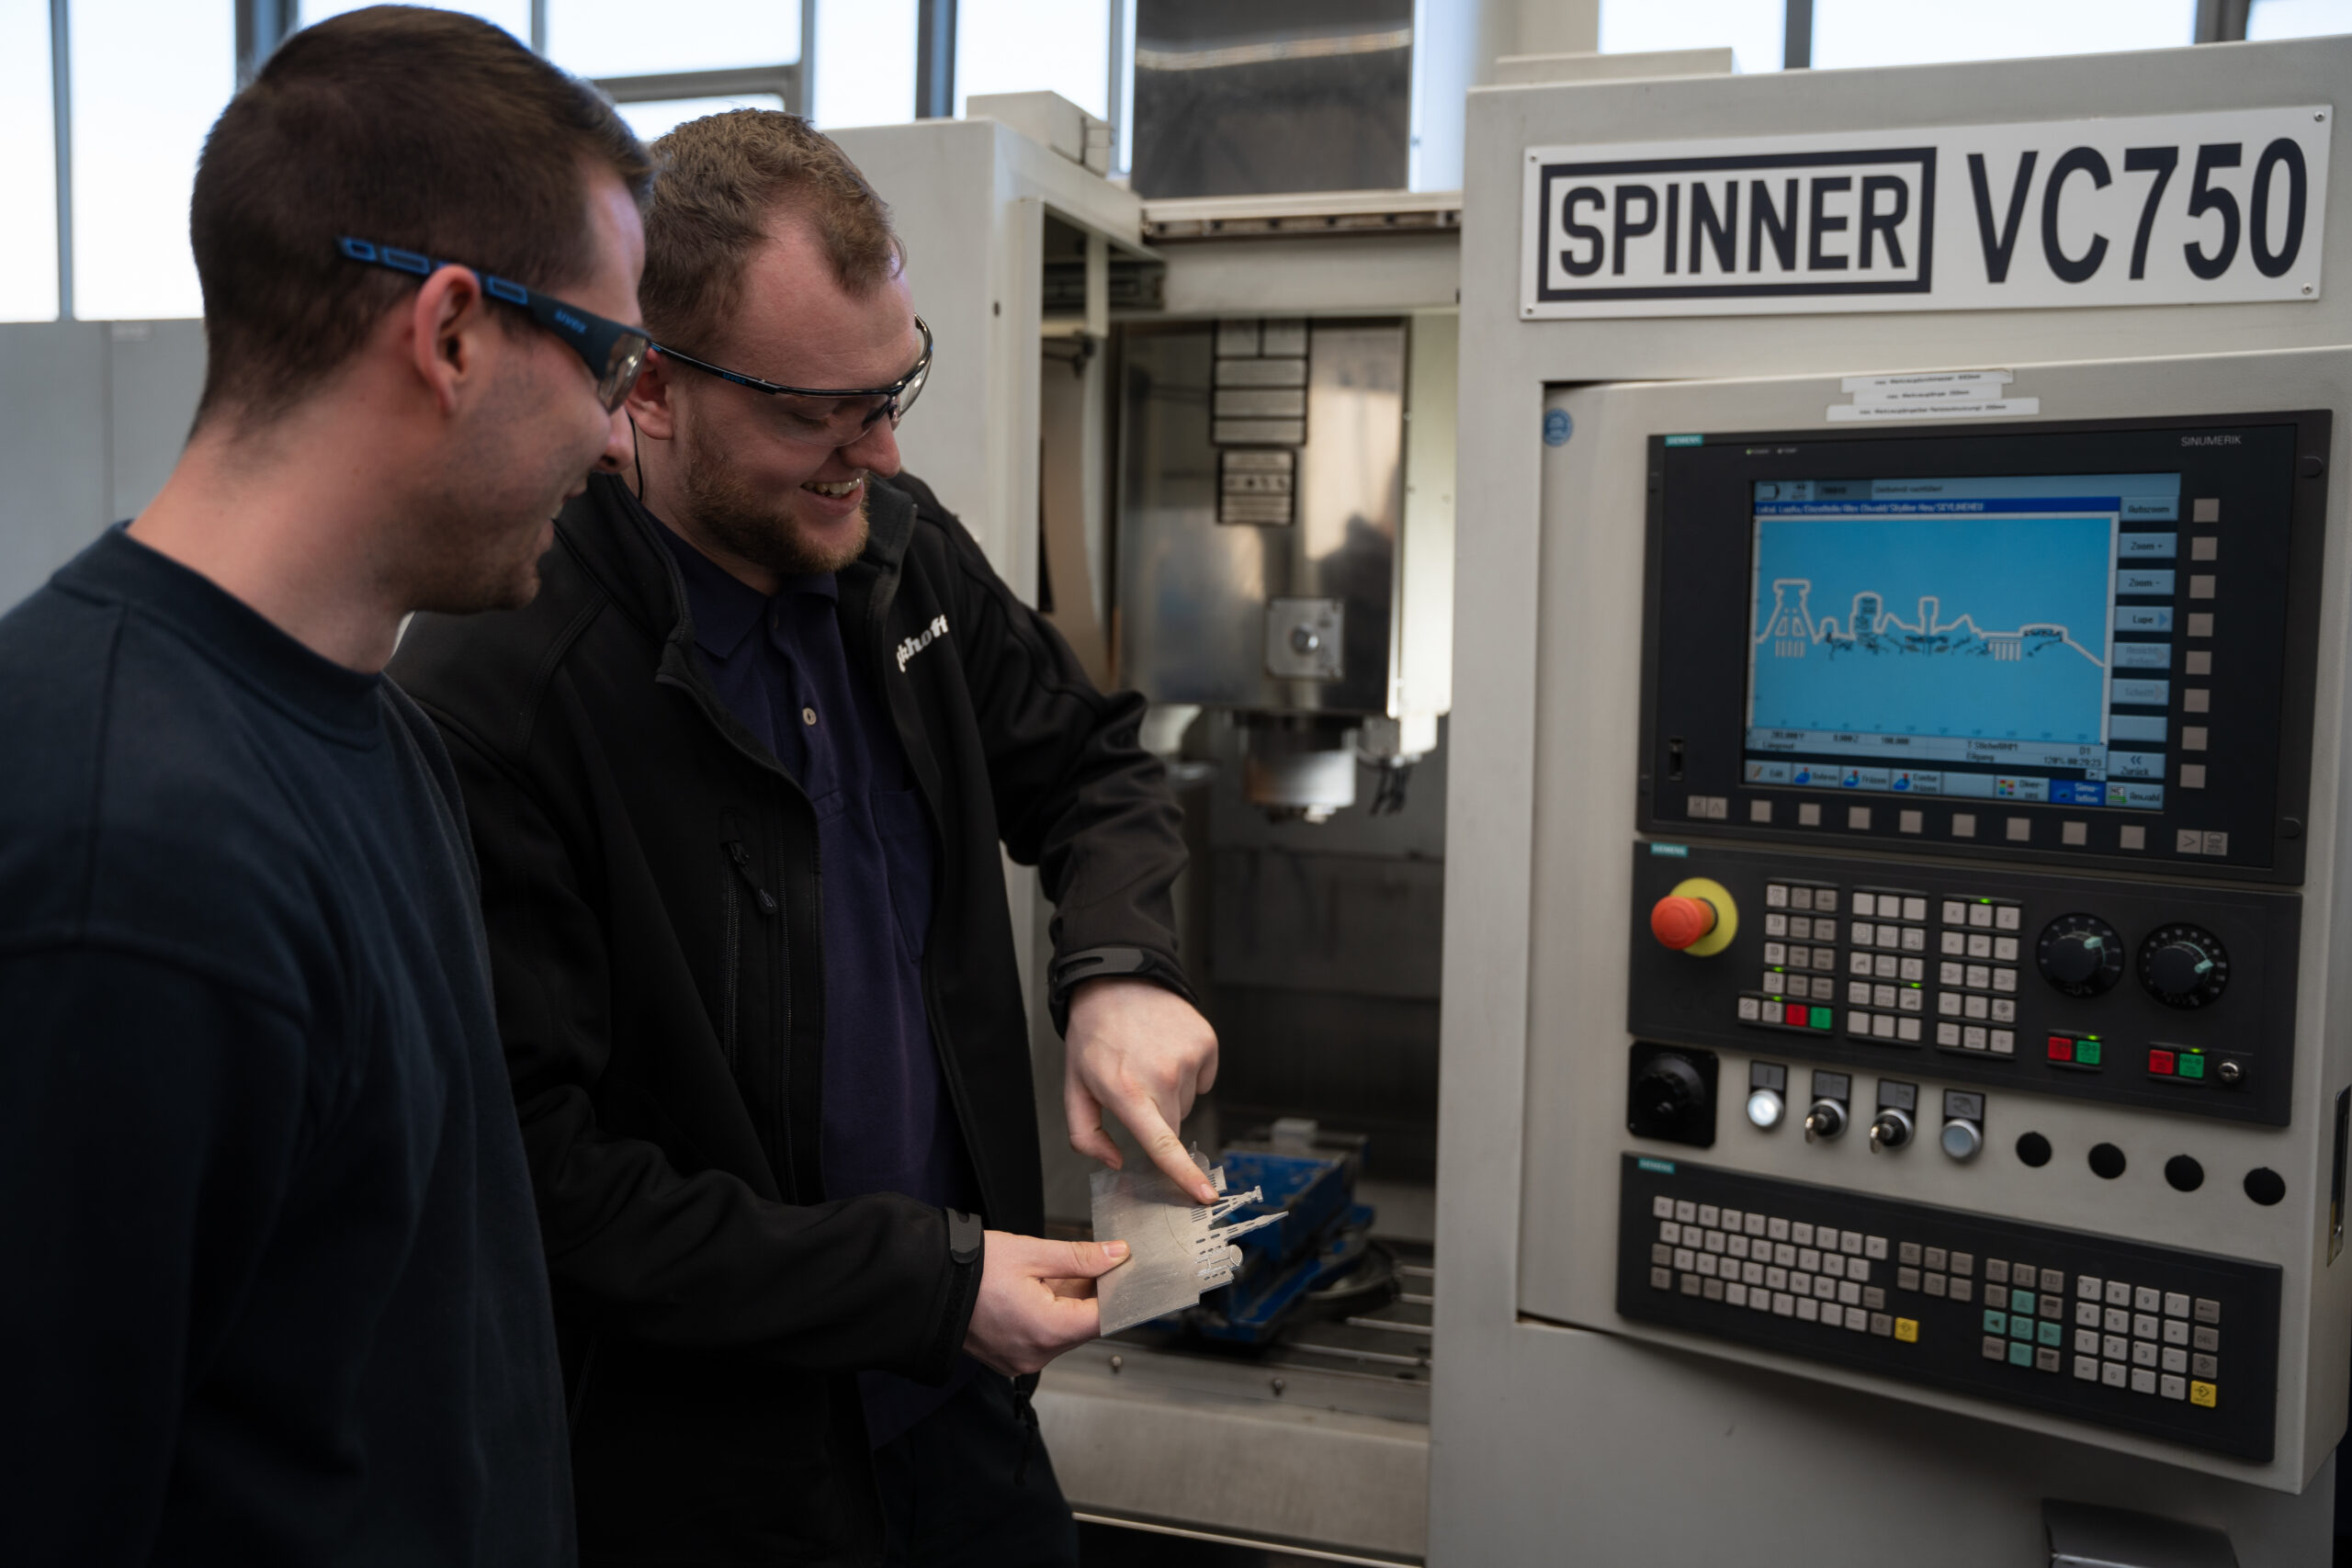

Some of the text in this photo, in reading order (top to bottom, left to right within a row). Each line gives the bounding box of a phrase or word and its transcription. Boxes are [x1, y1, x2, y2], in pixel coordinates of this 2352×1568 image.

[1560, 138, 2307, 284] SPINNER VC750
[2180, 434, 2242, 447] SINUMERIK
[2128, 504, 2170, 515] Autozoom
[2131, 541, 2154, 551] Zoom
[2129, 578, 2153, 588] Zoom
[2132, 615, 2154, 626] Lupe
[2120, 765, 2149, 777] Zurück
[2129, 793, 2161, 805] Anwahl
